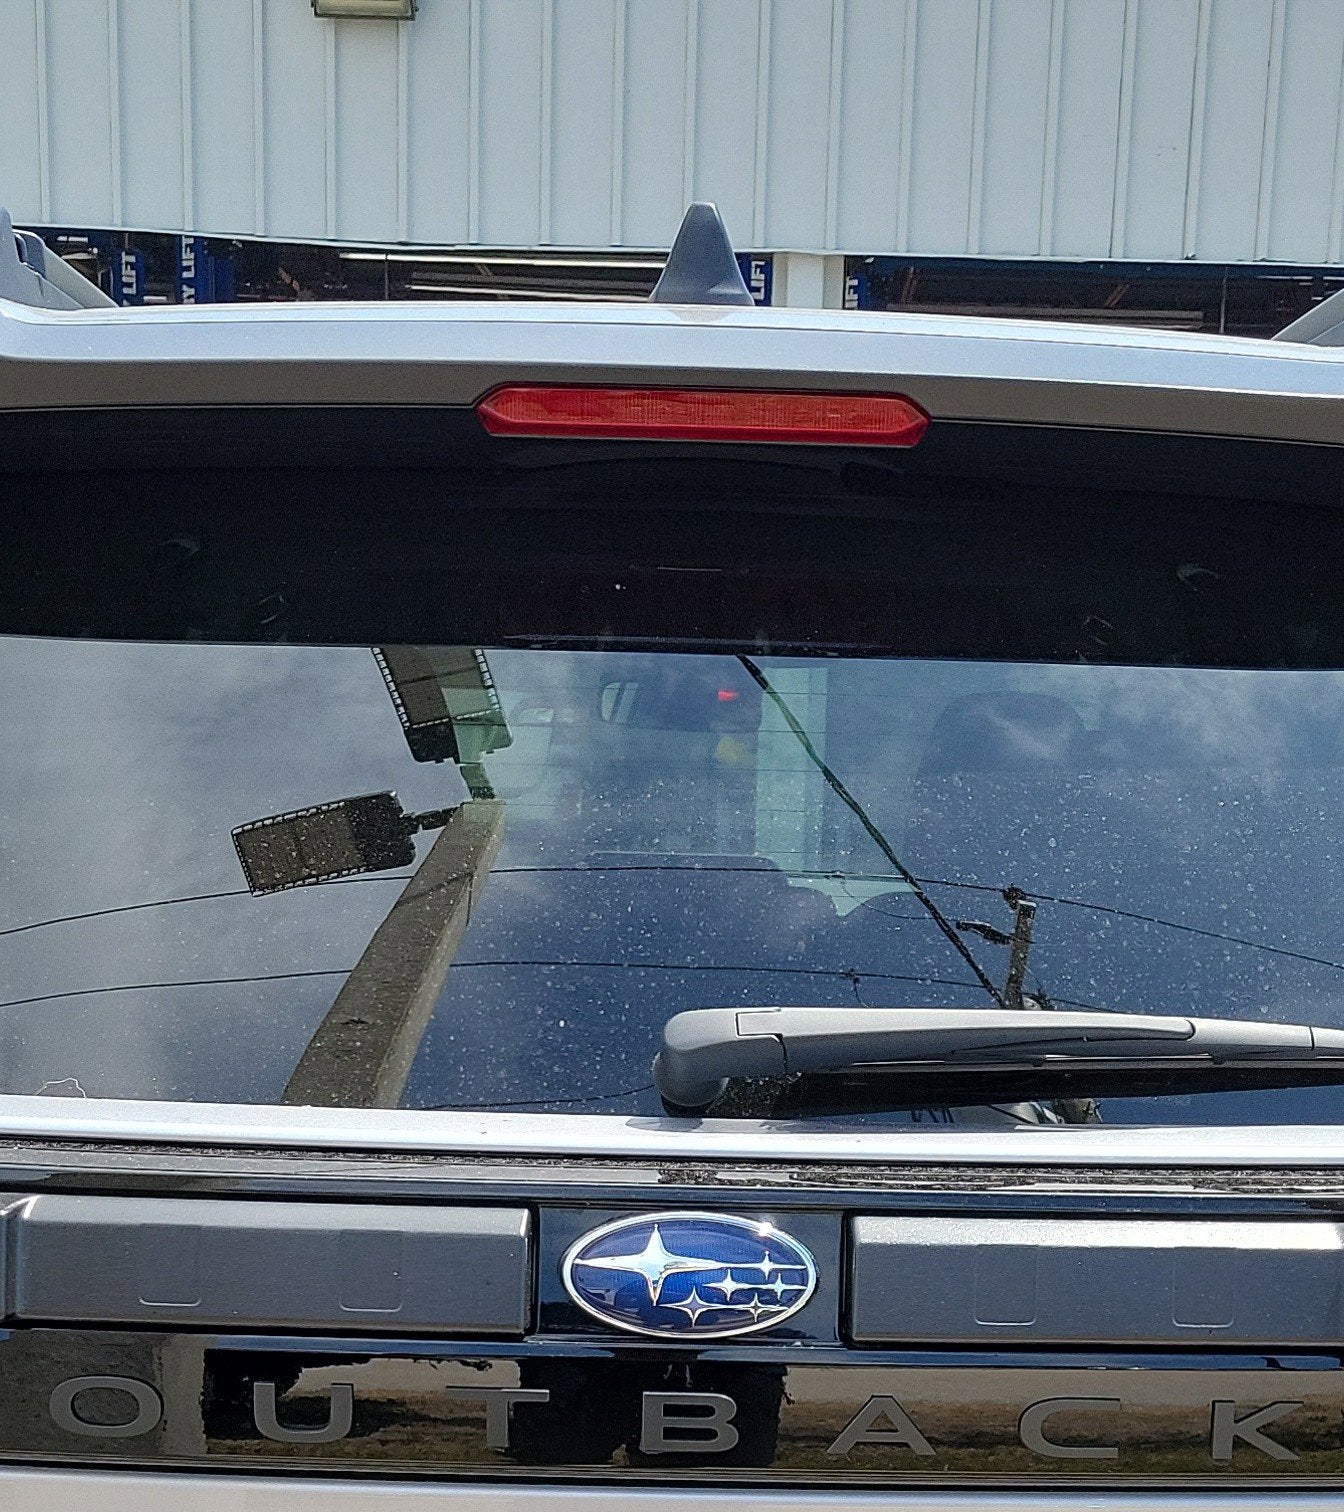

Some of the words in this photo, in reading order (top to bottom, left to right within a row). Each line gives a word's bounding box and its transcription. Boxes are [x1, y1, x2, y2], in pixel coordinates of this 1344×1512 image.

[121, 251, 136, 295] LIFT
[182, 235, 195, 278] LIFT
[750, 260, 766, 300] LIFT
[845, 276, 858, 308] IFT
[49, 1376, 1304, 1461] OUTBACK
